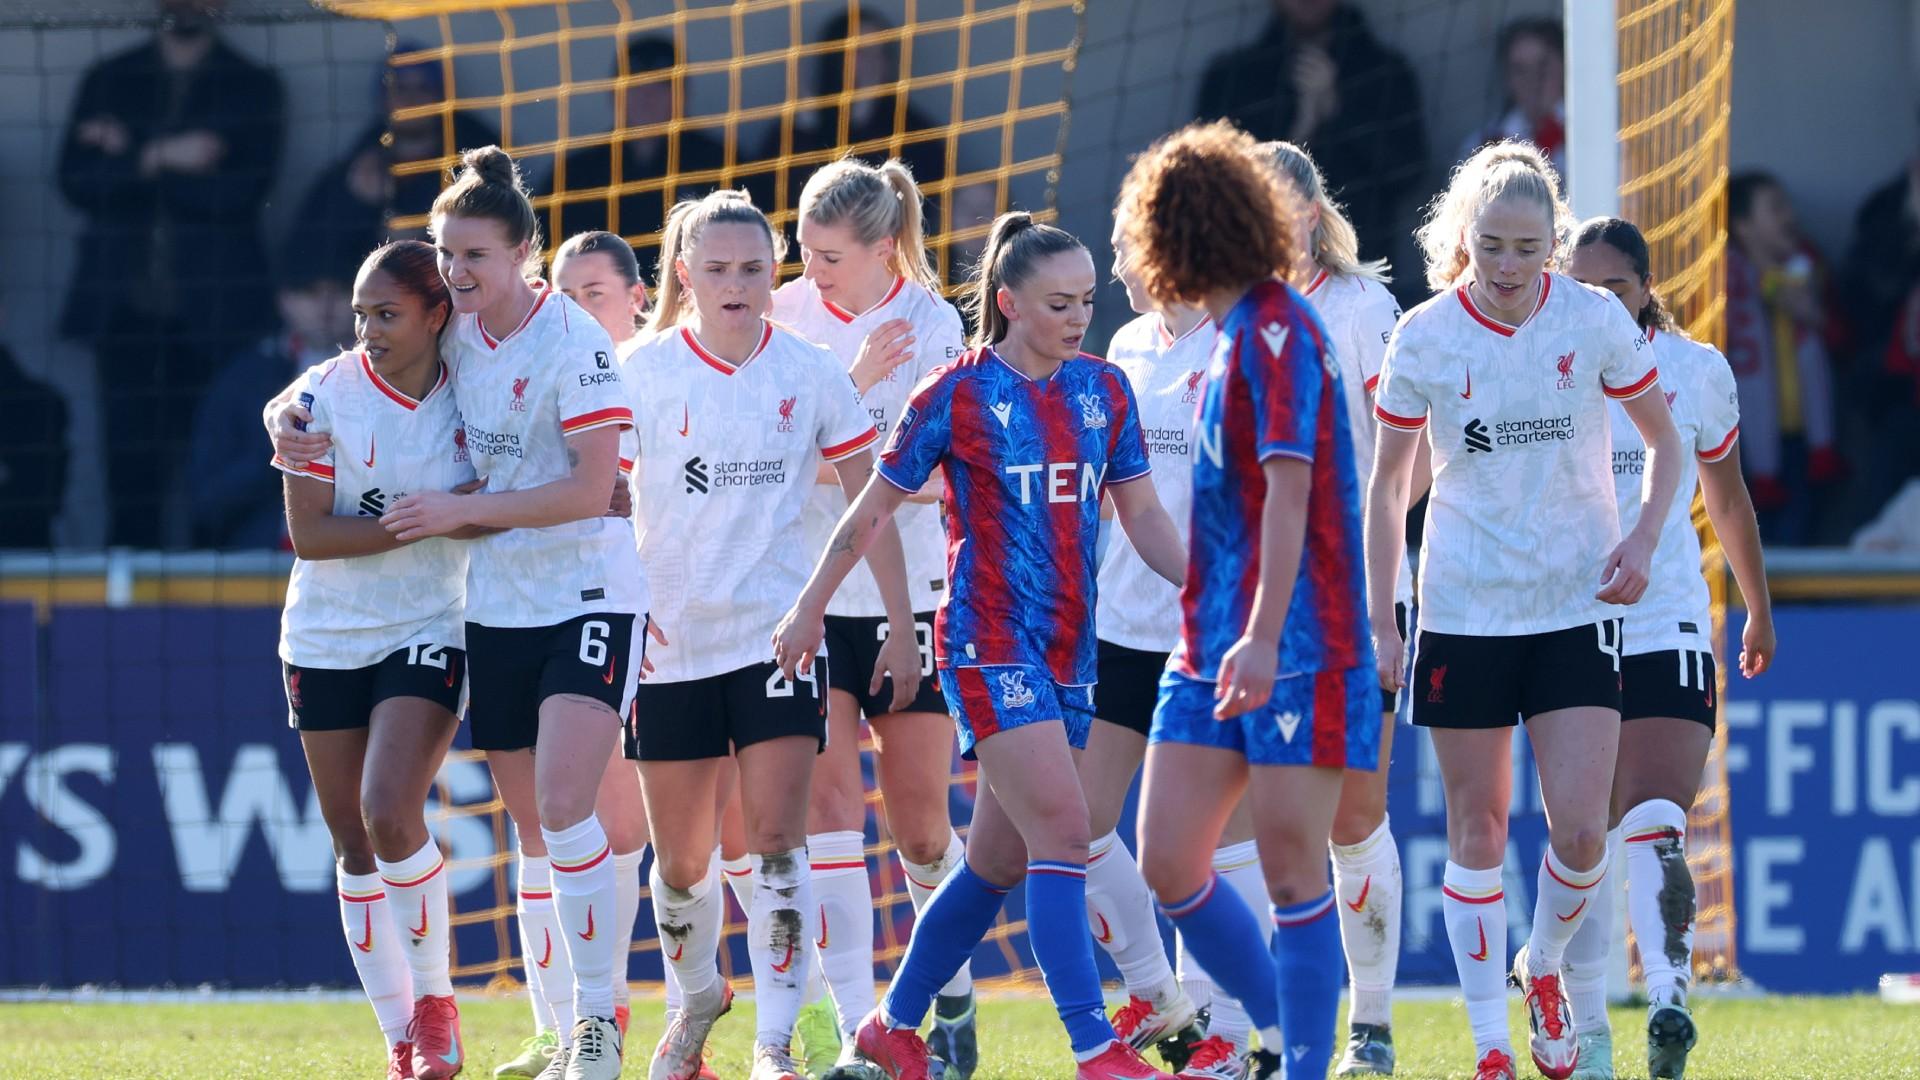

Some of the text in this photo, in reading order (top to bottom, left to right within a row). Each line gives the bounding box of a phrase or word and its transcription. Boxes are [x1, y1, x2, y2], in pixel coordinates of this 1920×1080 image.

[579, 370, 621, 387] Exped
[1556, 380, 1577, 390] LFC
[509, 401, 527, 412] LFC
[1181, 393, 1198, 404] LFC
[777, 424, 795, 433] LFC
[1495, 414, 1571, 434] standard
[467, 424, 520, 445] standard
[1496, 426, 1575, 446] chartered
[467, 438, 523, 459] chartered
[714, 459, 783, 475] standard
[714, 472, 785, 488] chartered
[1005, 462, 1108, 505] TEN
[578, 620, 610, 666] 6
[407, 643, 447, 670] 12
[1677, 649, 1704, 691] 11
